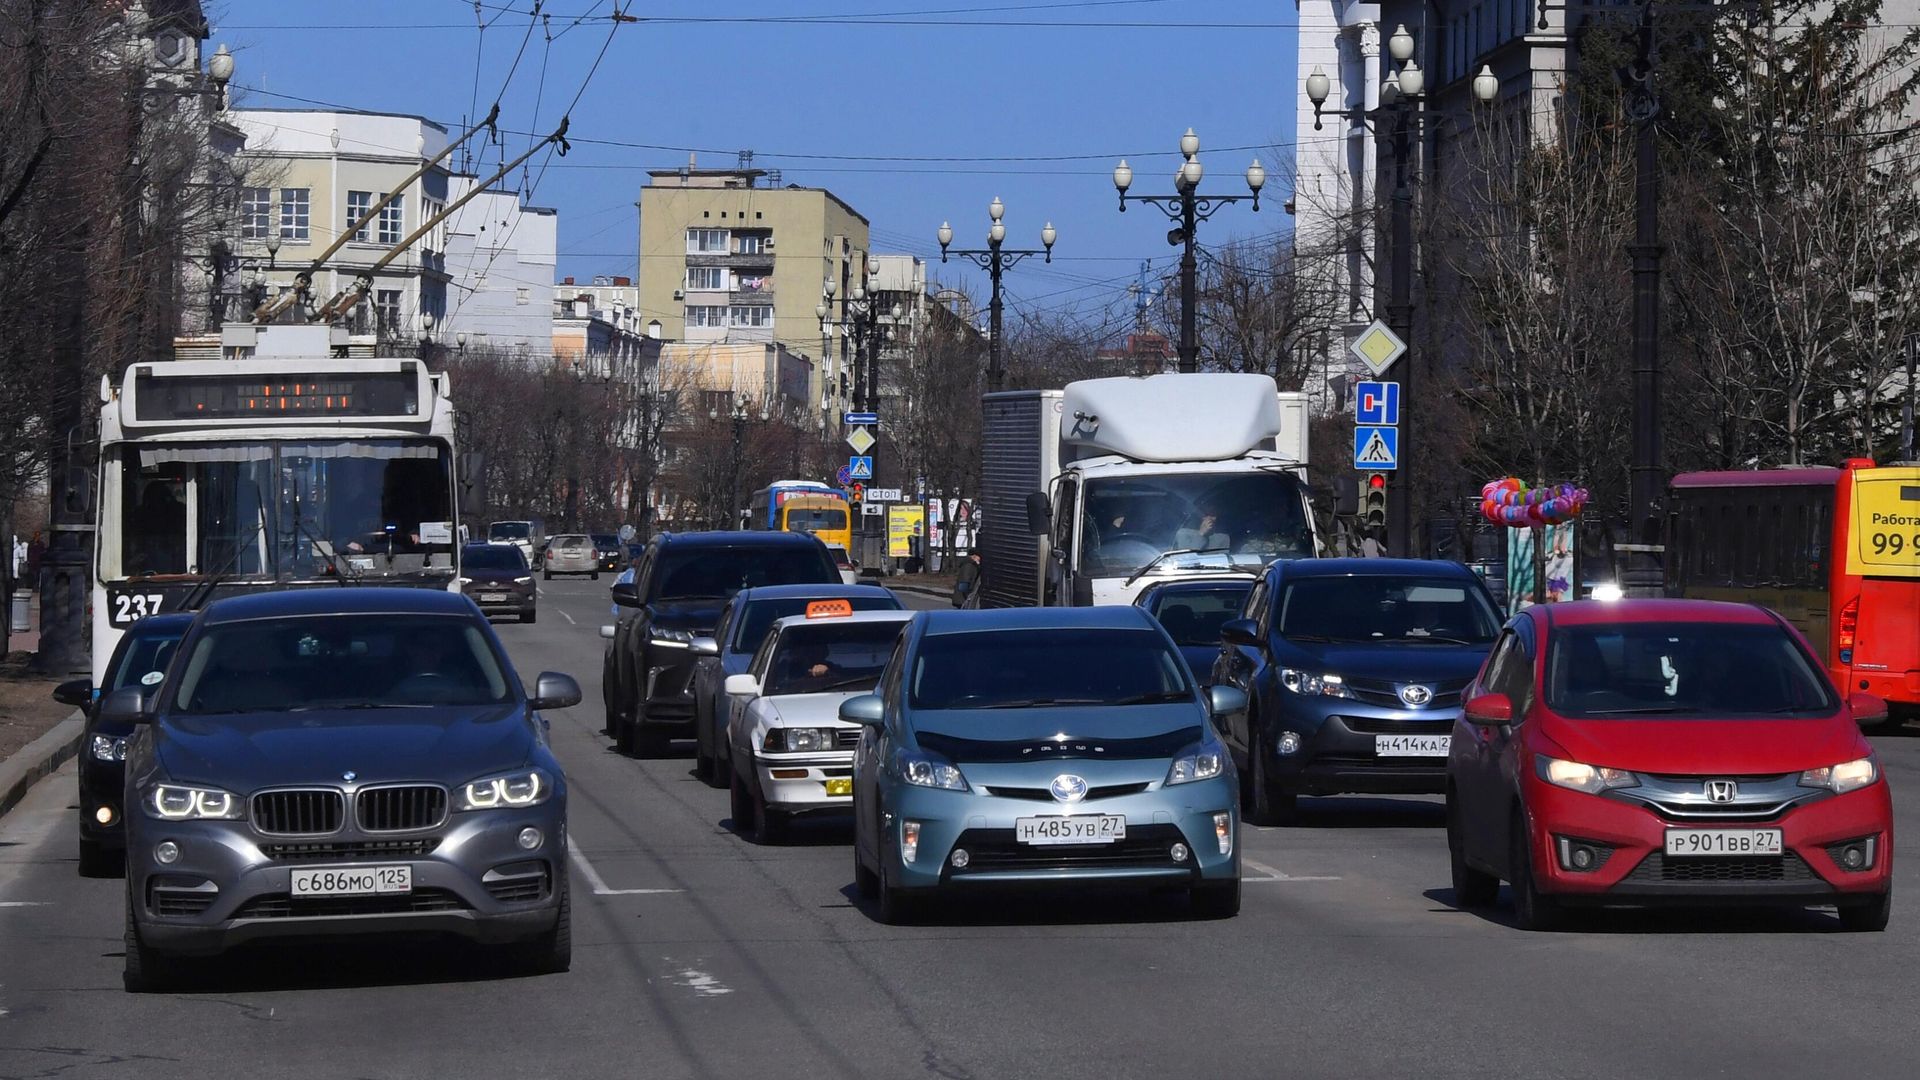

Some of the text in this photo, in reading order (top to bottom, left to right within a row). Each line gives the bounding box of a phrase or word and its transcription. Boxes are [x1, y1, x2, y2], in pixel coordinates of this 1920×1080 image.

[872, 490, 897, 499] СТОП
[1873, 513, 1920, 525] Работа
[116, 594, 163, 622] 237
[1382, 738, 1438, 751] Н414КА
[1025, 818, 1118, 838] Н485УВ 27
[1675, 832, 1774, 851] Р901ВВ 27
[297, 869, 406, 891] С686МО 125
